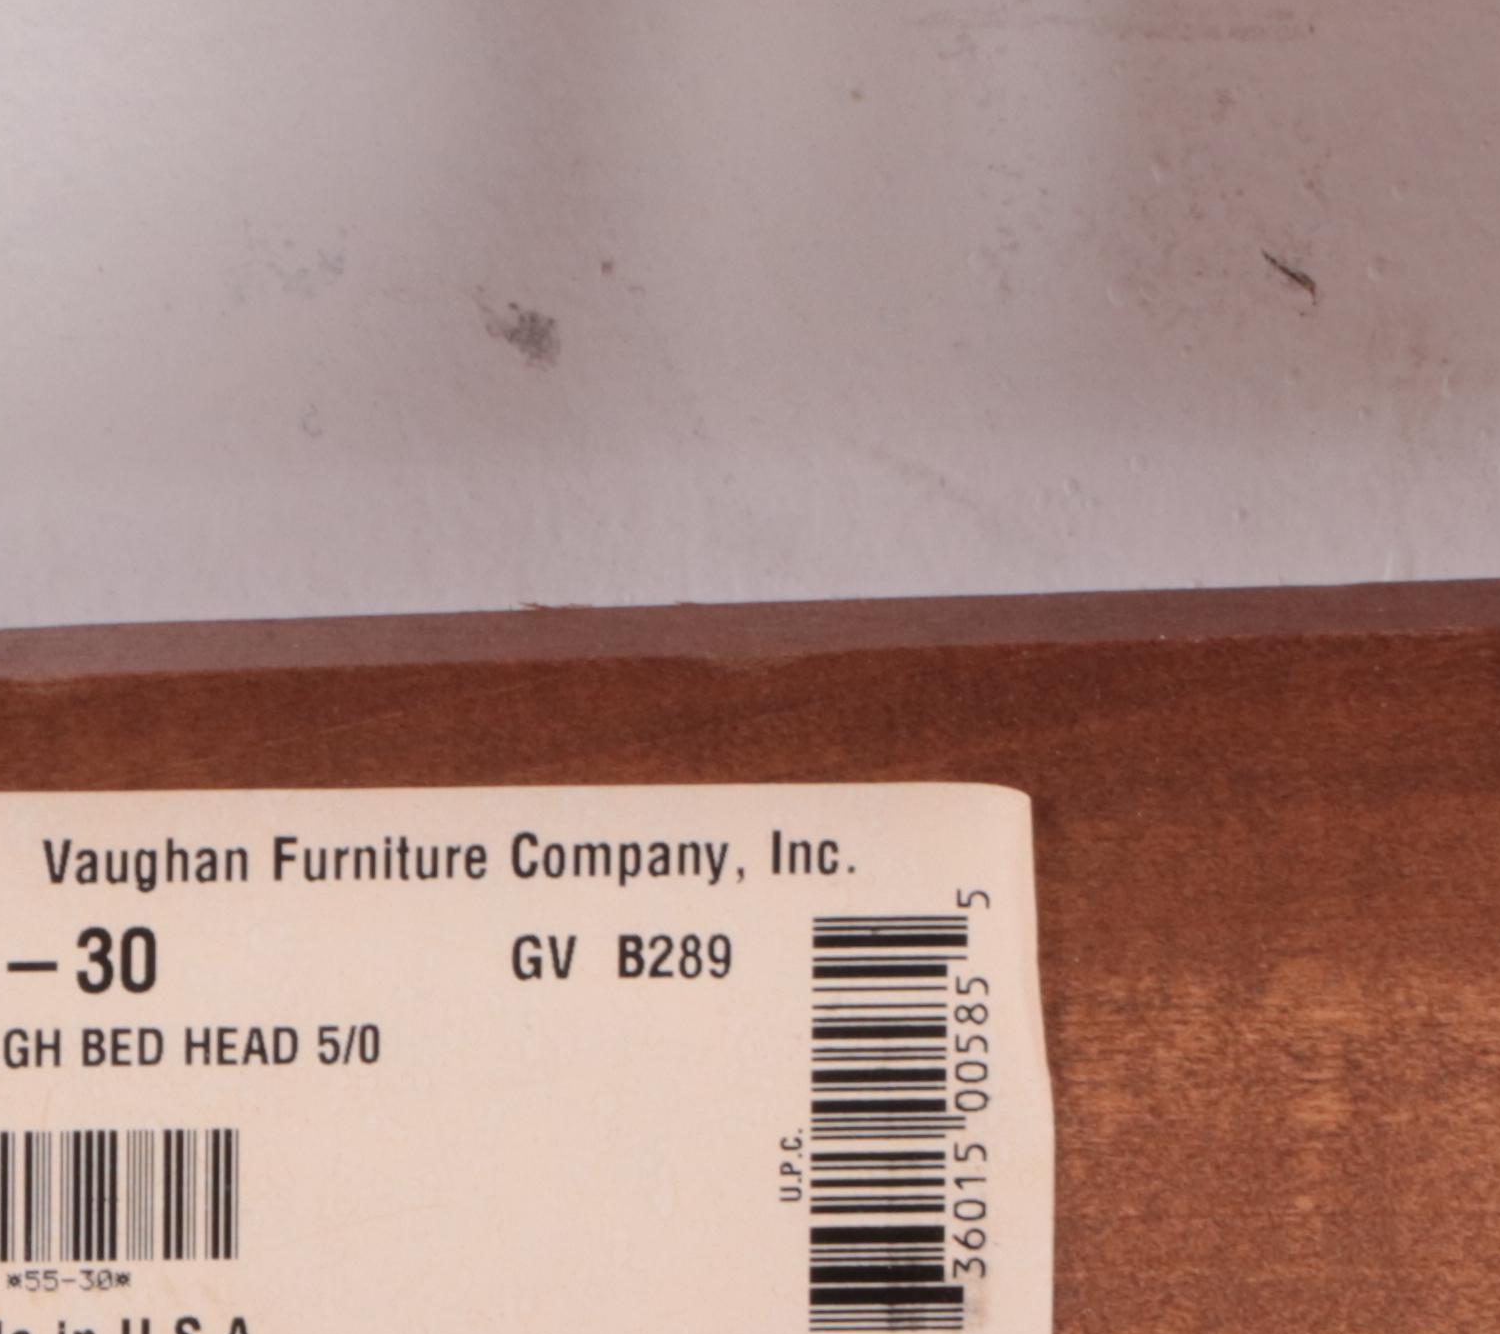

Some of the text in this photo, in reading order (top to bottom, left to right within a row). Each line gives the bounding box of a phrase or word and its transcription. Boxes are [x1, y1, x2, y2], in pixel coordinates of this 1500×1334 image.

[42, 829, 856, 894] Vaughan Furniture Company, Inc.
[956, 889, 990, 909] 5
[511, 933, 732, 982] GV B289
[81, 1027, 164, 1068] BED
[184, 1026, 299, 1066] HEAD
[317, 1023, 380, 1066] 5/0
[953, 976, 990, 1113] 00585
[779, 1128, 803, 1202] U.P.C.
[951, 1143, 988, 1280] 36015
